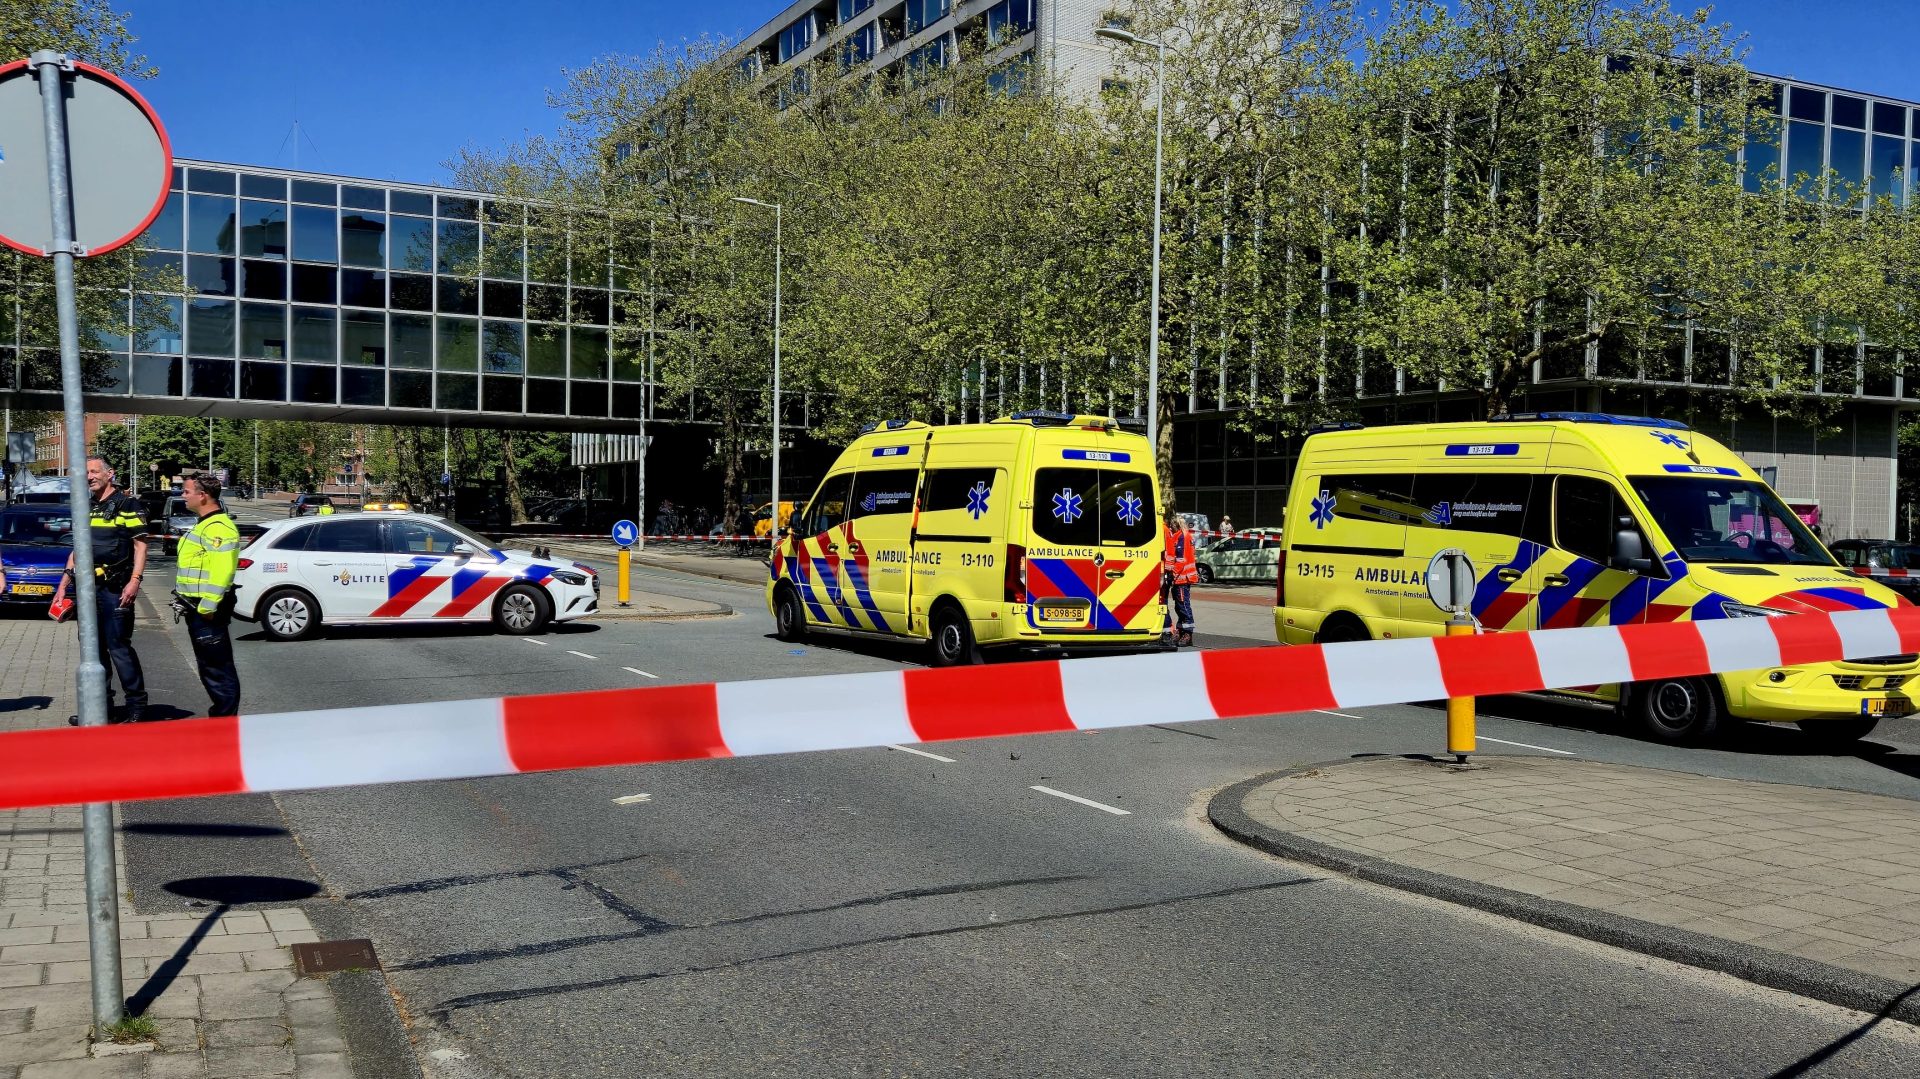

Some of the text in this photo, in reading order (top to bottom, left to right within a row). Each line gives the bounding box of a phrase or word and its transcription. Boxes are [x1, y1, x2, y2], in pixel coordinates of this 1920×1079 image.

[1028, 548, 1093, 557] AMBULANCE
[1123, 549, 1149, 559] 13-110
[960, 553, 994, 568] 13-110
[1297, 562, 1334, 579] 13-115
[1354, 567, 1429, 586] AMBULAN
[1365, 587, 1399, 597] Amsterdam
[1403, 590, 1430, 600] Amstella
[1046, 609, 1082, 618] S-098-SB
